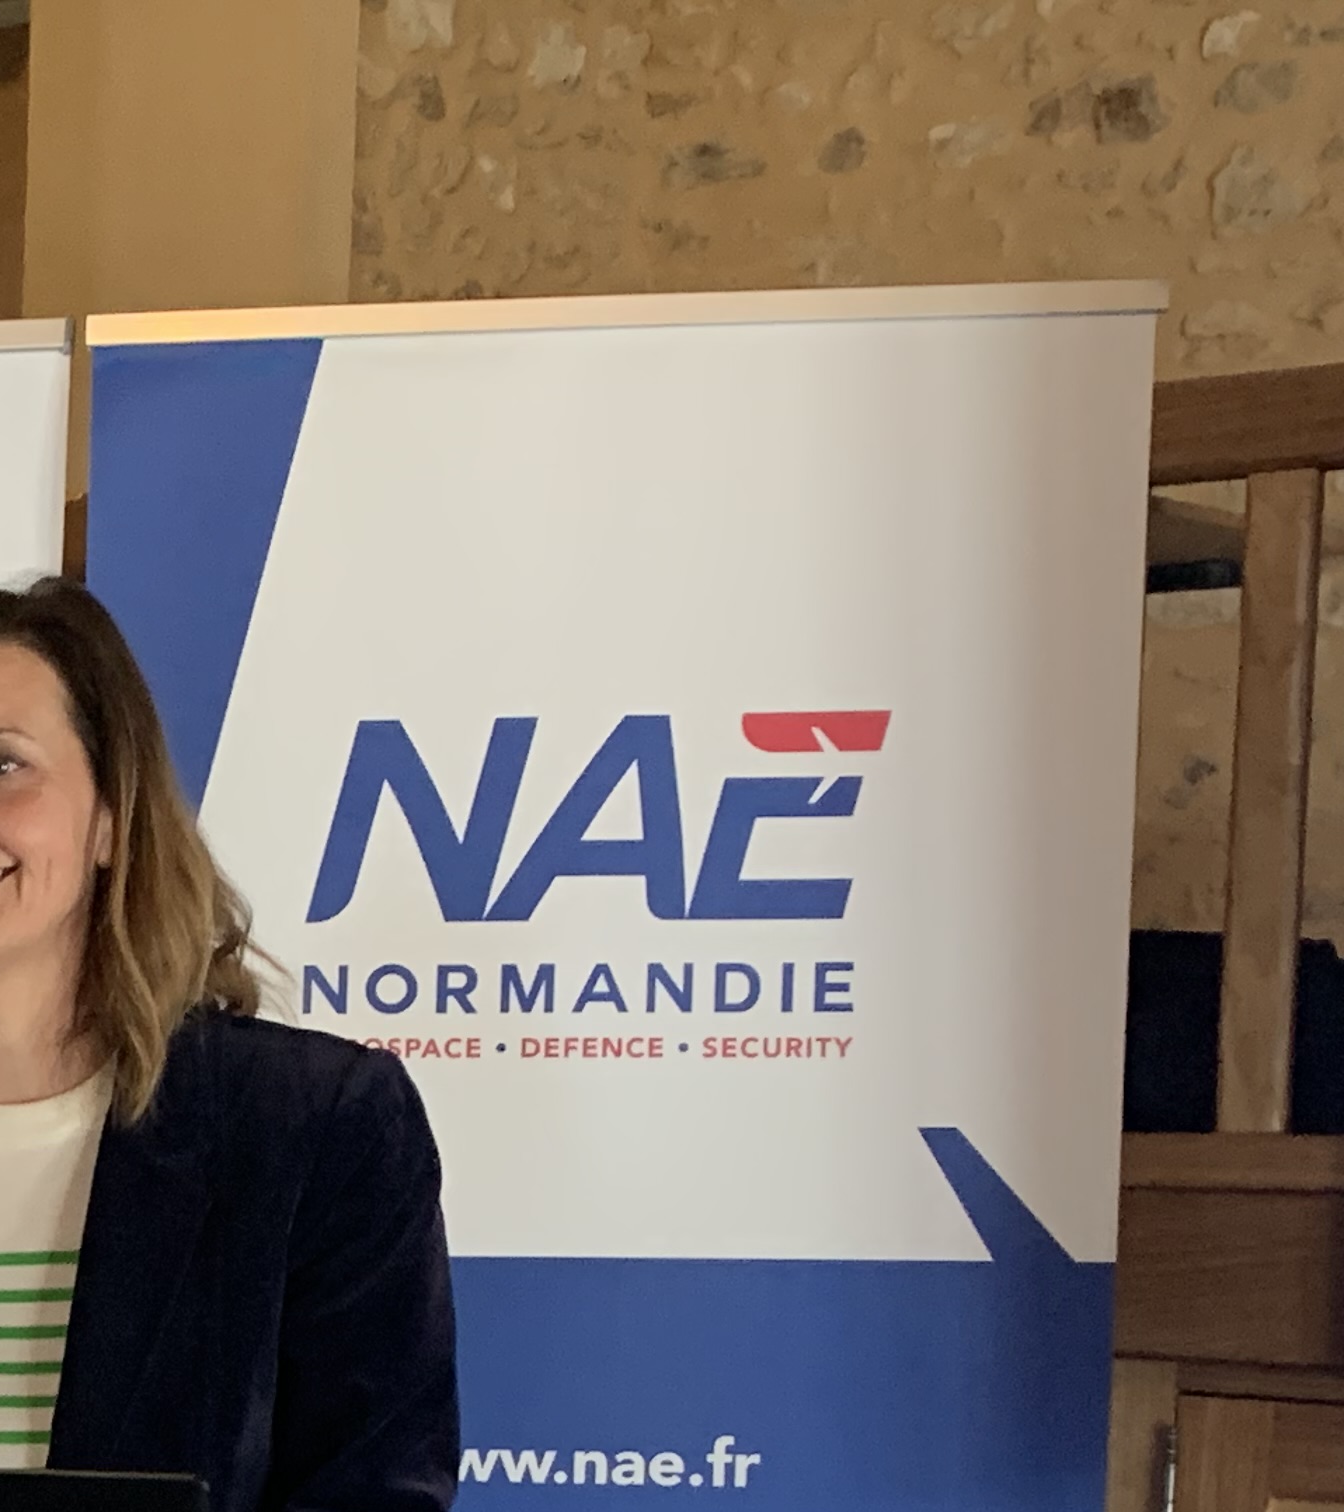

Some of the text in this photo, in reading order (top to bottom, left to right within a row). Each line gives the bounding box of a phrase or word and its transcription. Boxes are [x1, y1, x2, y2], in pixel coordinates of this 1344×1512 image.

[305, 709, 892, 924] NAE
[301, 961, 855, 1014] NORMANDIE
[520, 1036, 665, 1060] DEFENCE
[701, 1035, 854, 1060] SECURITY
[458, 1434, 762, 1489] ww.nae.fr
